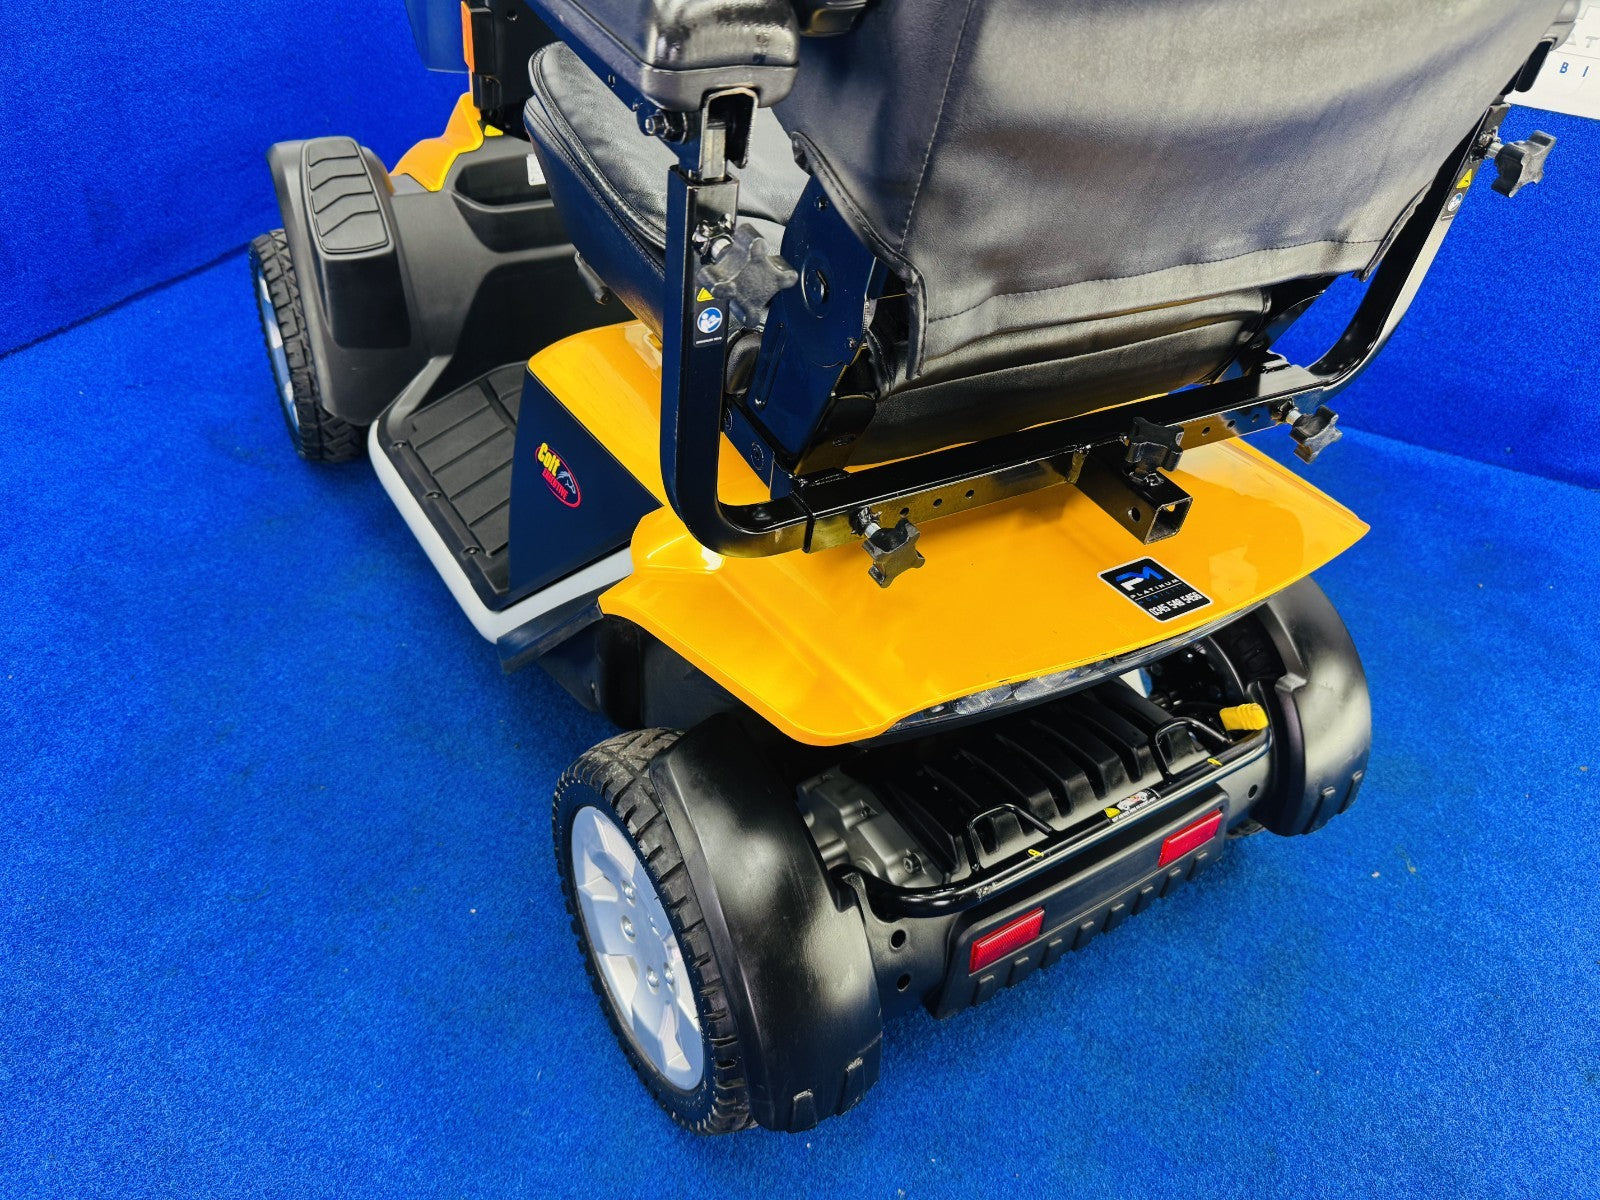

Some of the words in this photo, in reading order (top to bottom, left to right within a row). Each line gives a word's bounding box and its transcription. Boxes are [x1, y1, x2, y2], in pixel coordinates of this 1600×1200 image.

[537, 442, 561, 477] Colt
[1129, 578, 1181, 600] PLATINUM
[1148, 603, 1171, 616] 0345
